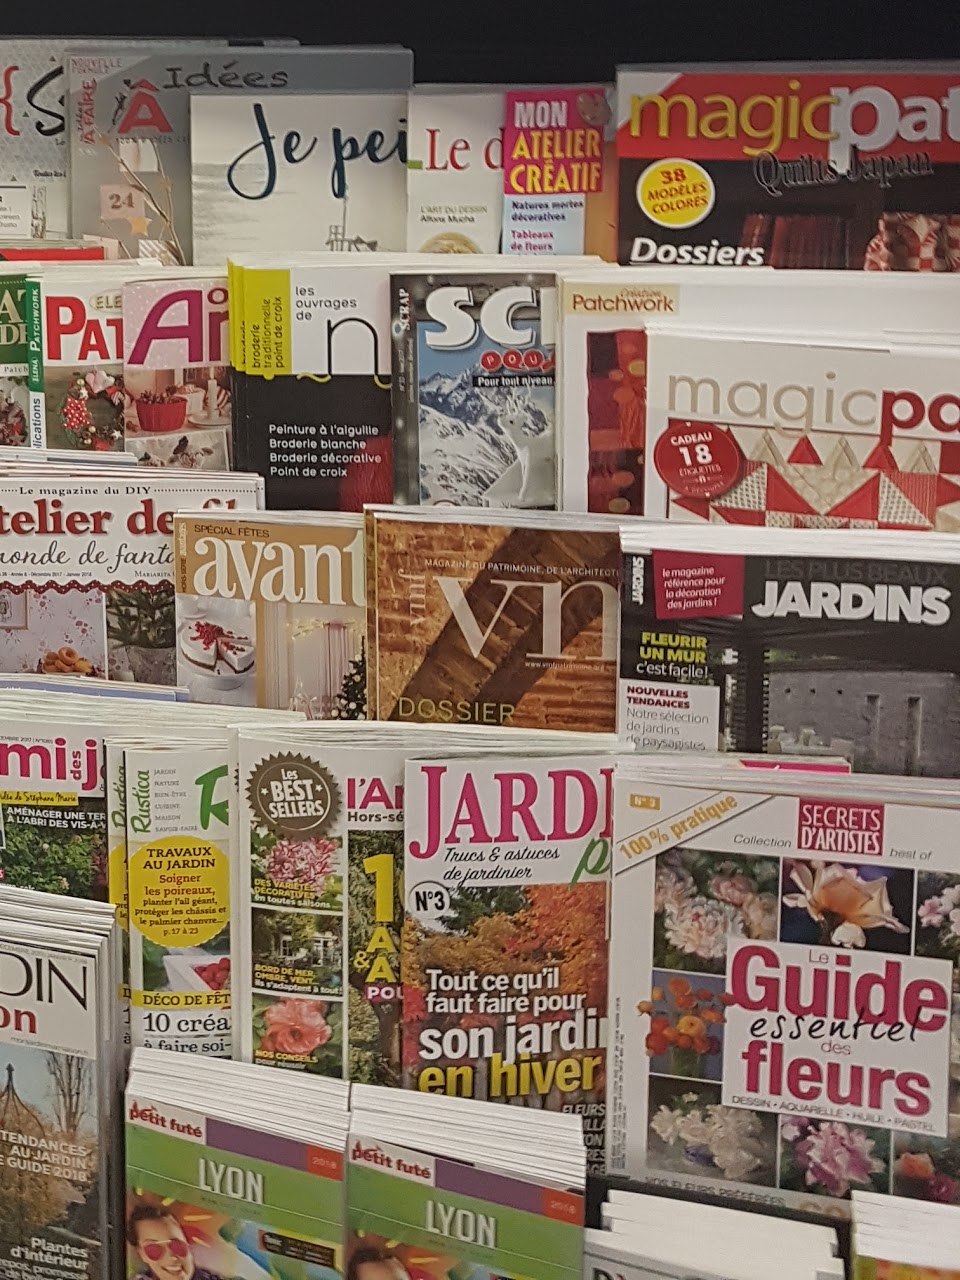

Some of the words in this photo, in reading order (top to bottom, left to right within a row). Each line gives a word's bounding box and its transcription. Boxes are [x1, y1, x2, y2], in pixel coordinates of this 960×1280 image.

[167, 60, 289, 89] Idées
[514, 101, 567, 128] MON
[513, 131, 600, 161] ATELIER
[511, 161, 600, 193] CRÉATIF
[660, 169, 686, 184] 38
[647, 181, 707, 201] MODÈLES
[511, 201, 548, 210] Natures
[552, 201, 583, 209] mortes
[652, 195, 708, 214] COLORÉS
[511, 212, 566, 222] décoratives
[630, 237, 764, 266] Dossiers
[295, 286, 314, 297] les
[295, 298, 356, 310] ouvrages
[573, 293, 674, 313] Patchwork
[296, 310, 312, 321] de
[478, 377, 500, 386] Pour
[502, 377, 519, 386] tout
[522, 376, 552, 388] niveau
[269, 424, 316, 436] Peinture
[319, 426, 327, 435] à
[331, 424, 378, 437] l'aiguille
[670, 432, 712, 446] CADEAU
[270, 438, 318, 449] Broderie
[321, 438, 366, 450] blanche
[270, 452, 319, 464] Broderie
[321, 452, 381, 466] décorative
[680, 445, 712, 466] 18
[270, 466, 299, 477] Point
[302, 467, 317, 477] de
[321, 467, 347, 478] croix
[20, 486, 33, 495] Le
[39, 486, 101, 496] magazine
[105, 486, 120, 495] du
[125, 486, 151, 495] DIY
[127, 497, 174, 534] de
[194, 524, 235, 536] SPÉCIAL
[239, 524, 269, 538] FÊTES
[79, 540, 107, 564] de
[664, 576, 703, 587] référence
[704, 576, 725, 587] pour
[751, 580, 951, 625] JARDINS
[642, 632, 707, 648] FLEURIR
[627, 686, 688, 698] NOUVELLES
[399, 698, 514, 722] DOSSIER
[281, 769, 298, 779] Les
[270, 779, 314, 801] BEST
[269, 799, 324, 817] SELLERS
[803, 804, 880, 830] SECRETS
[801, 827, 880, 854] D'ARTISTES
[147, 847, 211, 858] TRAVAUX
[444, 847, 485, 863] Trucs
[504, 847, 559, 861] astuces
[144, 858, 163, 869] AU
[167, 857, 215, 869] JARDIN
[426, 968, 480, 990] Tout
[483, 972, 508, 990] ce
[512, 968, 559, 993] qu'il
[731, 945, 949, 1032] Guide
[751, 1005, 923, 1043] essentiel
[419, 1028, 498, 1060] son
[419, 1063, 473, 1096] en
[489, 1053, 601, 1098] hiver
[741, 1040, 932, 1116] fleurs
[198, 1158, 264, 1205] LYON
[426, 1200, 495, 1248] LYON
